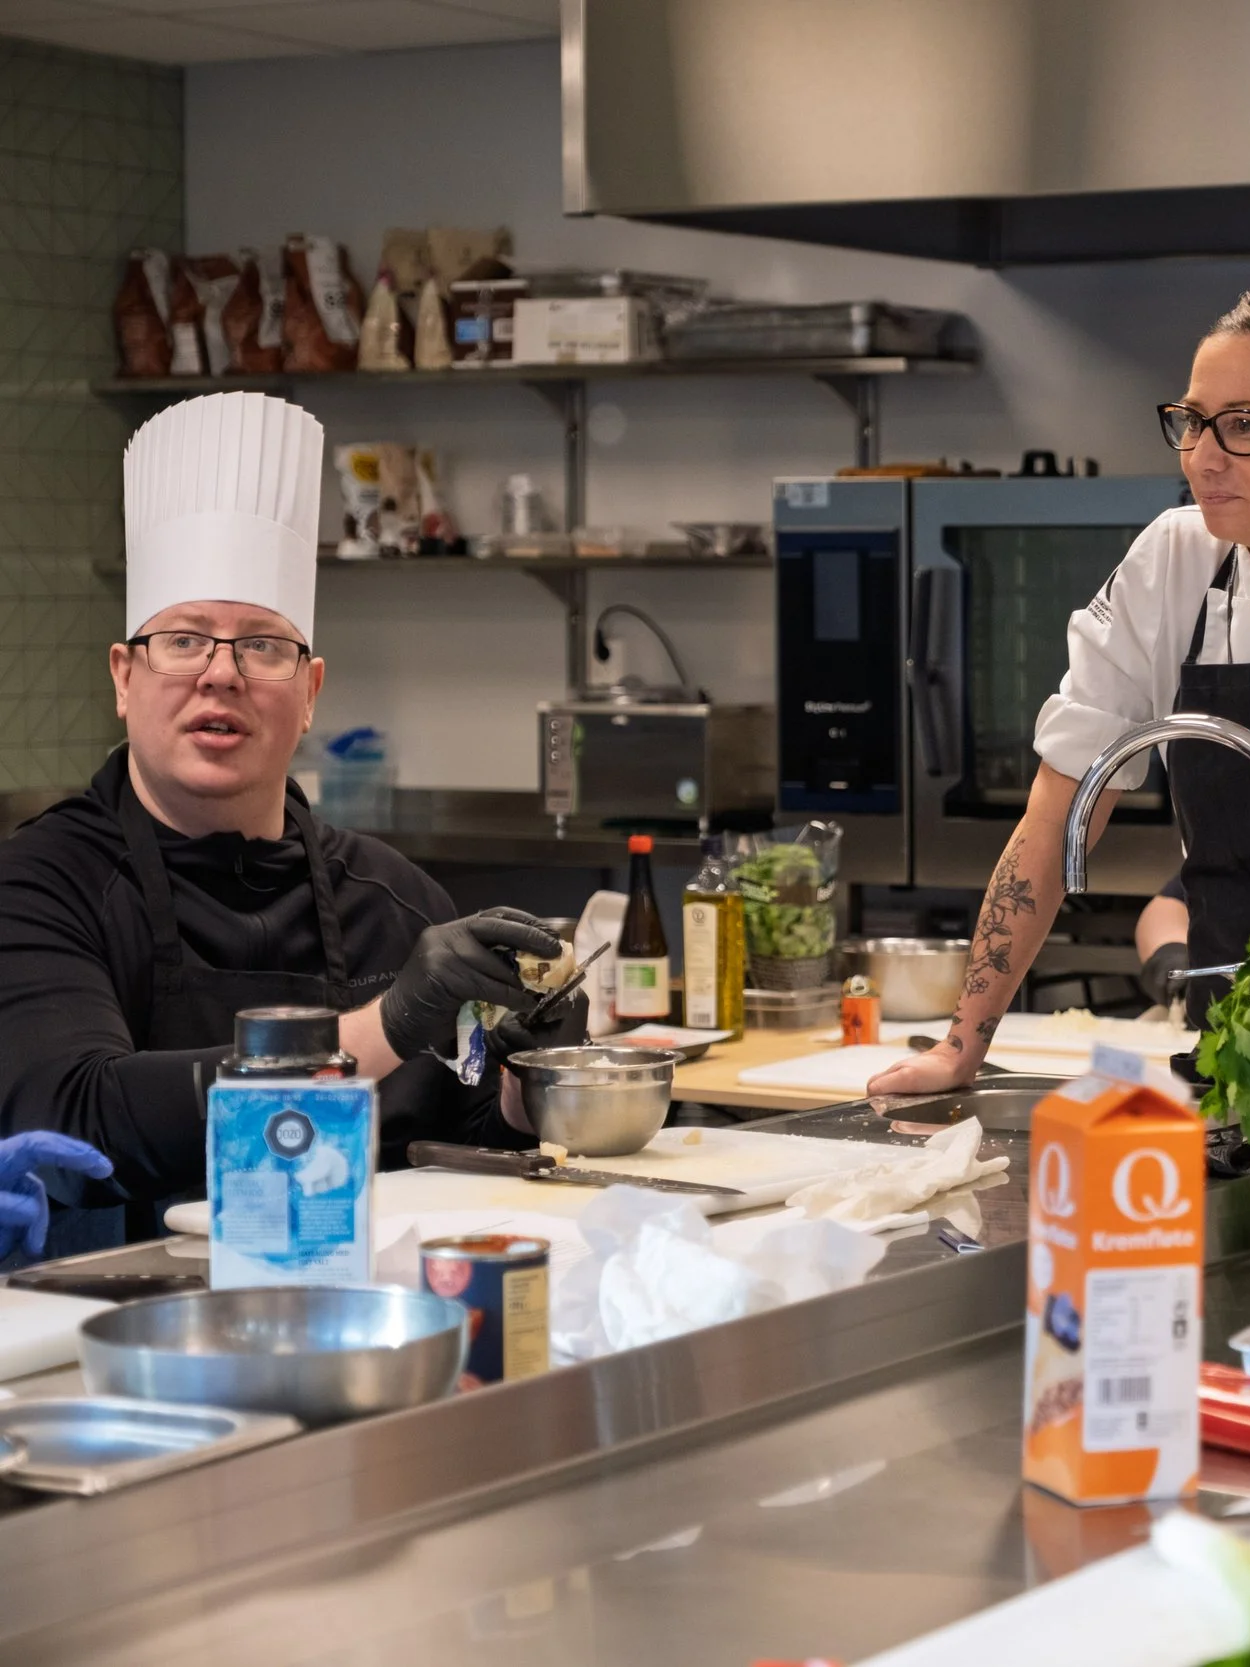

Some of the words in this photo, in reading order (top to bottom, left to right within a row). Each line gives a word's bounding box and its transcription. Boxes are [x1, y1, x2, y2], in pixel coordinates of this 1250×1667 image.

[348, 970, 400, 988] DURAN
[1037, 1142, 1077, 1218] Q
[1111, 1148, 1191, 1222] Q
